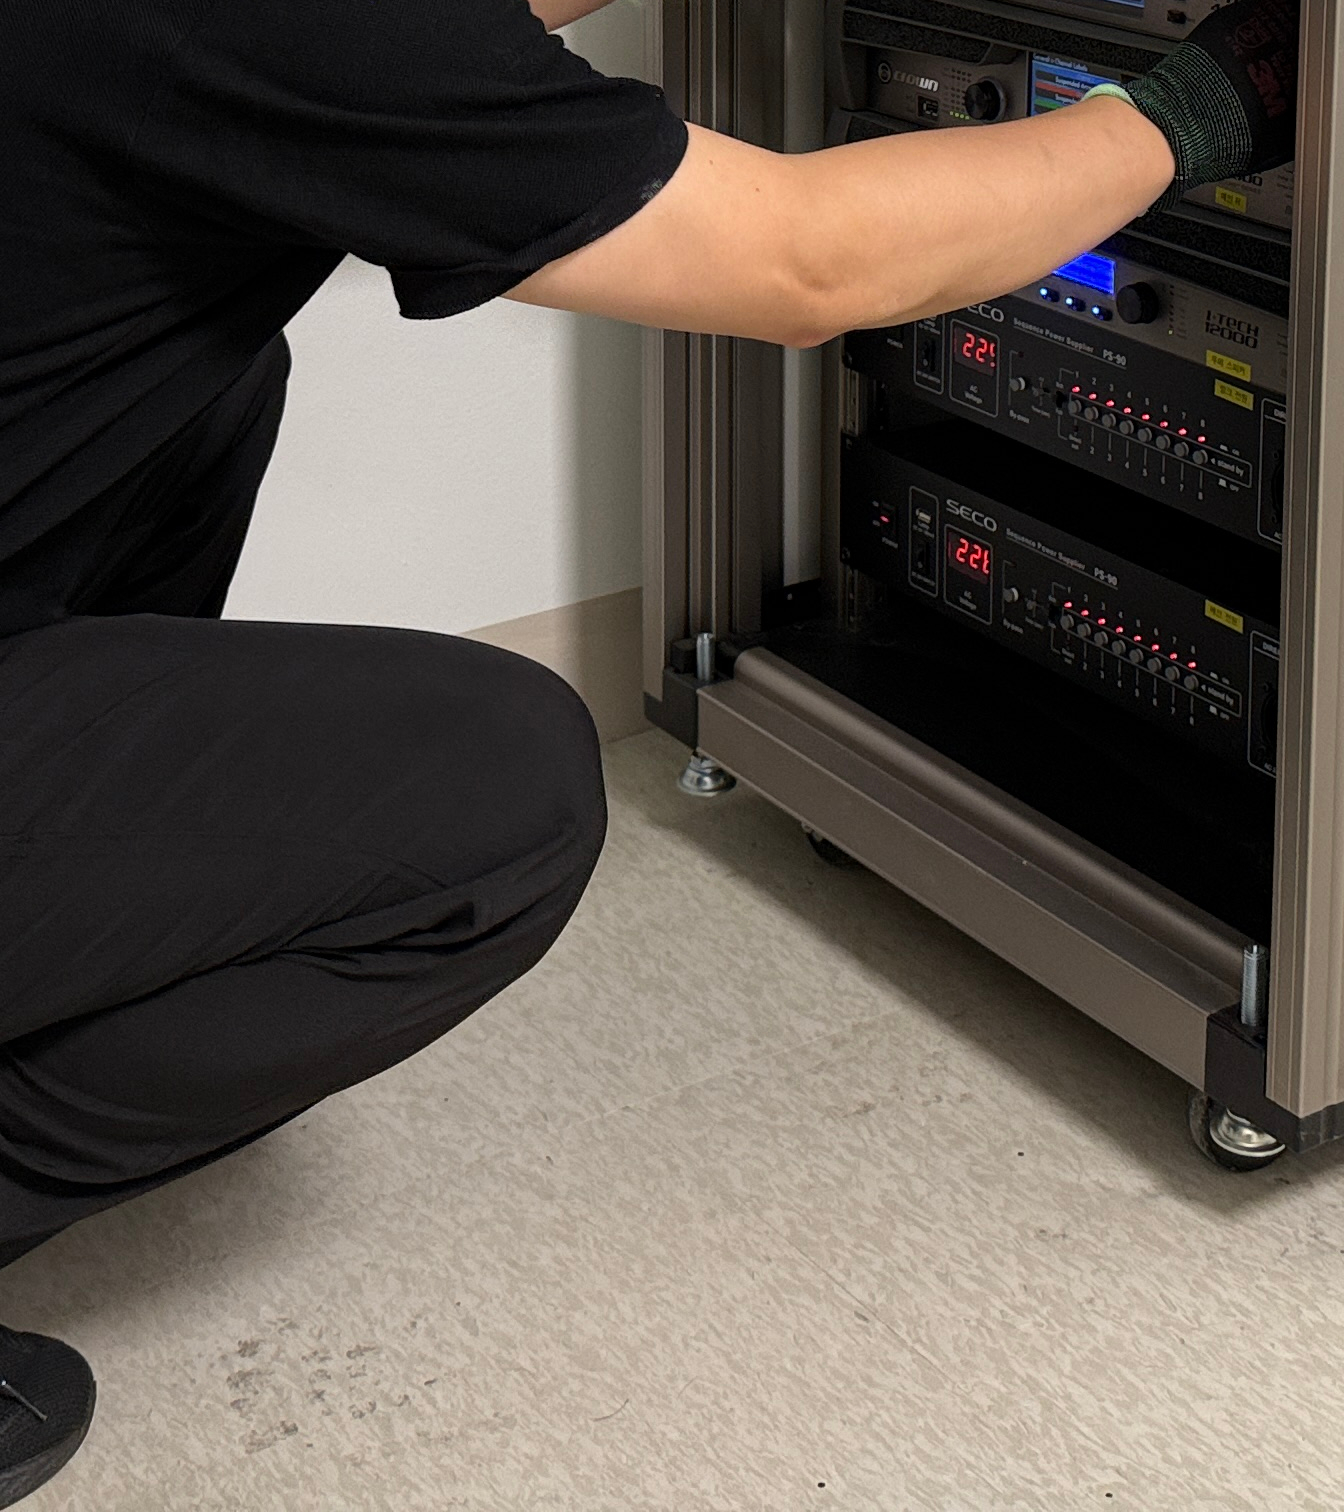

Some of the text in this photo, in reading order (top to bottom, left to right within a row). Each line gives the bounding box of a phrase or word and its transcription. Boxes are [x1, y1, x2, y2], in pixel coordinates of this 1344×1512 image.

[967, 304, 1005, 323] ECO
[1045, 328, 1065, 343] Power
[946, 499, 998, 532] SECO
